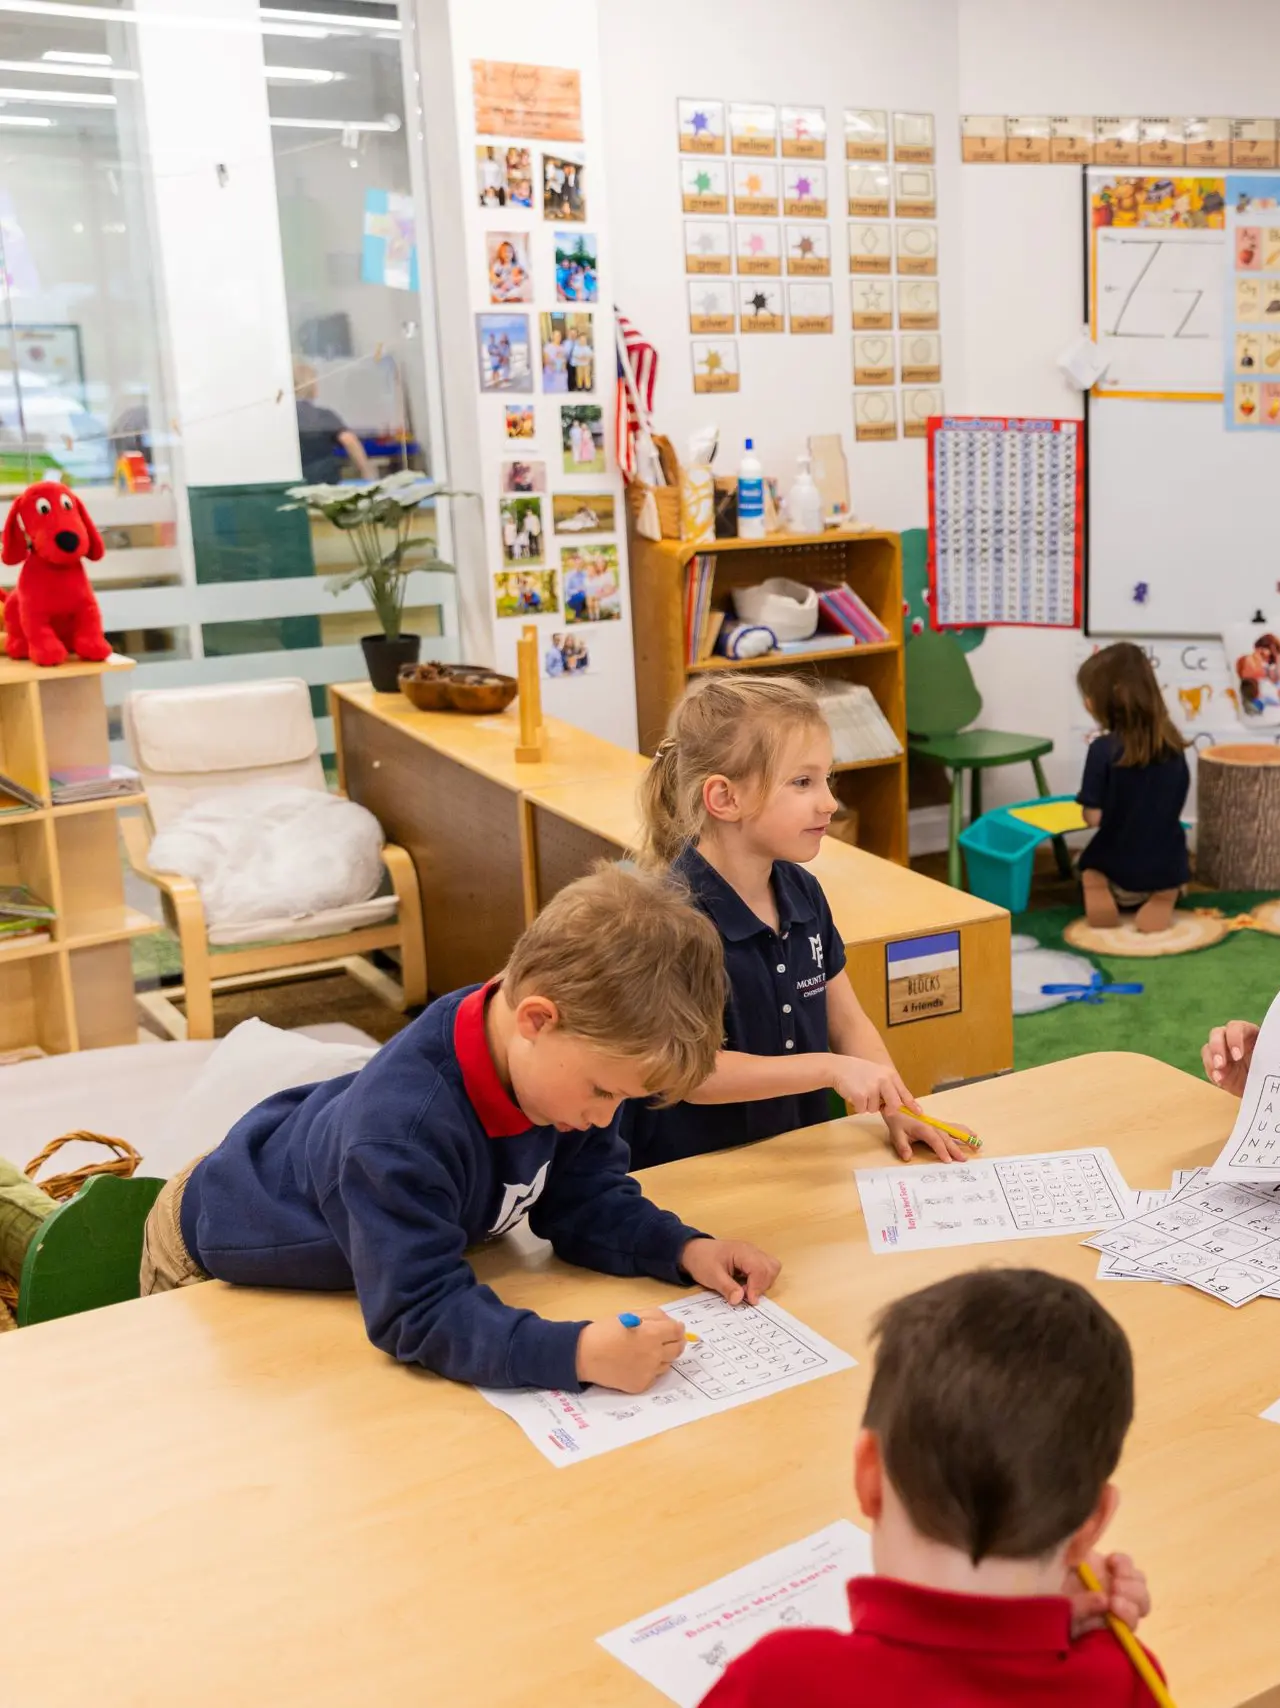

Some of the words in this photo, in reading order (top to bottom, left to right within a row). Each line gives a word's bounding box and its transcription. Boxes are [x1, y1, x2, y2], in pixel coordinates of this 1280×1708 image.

[737, 140, 770, 151] yellow
[690, 200, 720, 209] green
[739, 201, 774, 211] orange
[790, 203, 821, 214] purple
[700, 318, 727, 328] silver
[1181, 647, 1207, 671] Cc
[908, 976, 940, 996] BLOCKS
[902, 1004, 909, 1014] 4
[911, 999, 943, 1012] friends
[1200, 1201, 1224, 1213] n_p
[1156, 1221, 1180, 1232] v_t
[1248, 1219, 1271, 1231] f_x
[1154, 1262, 1177, 1271] f_n
[1250, 1258, 1278, 1270] m_n
[1205, 1277, 1229, 1292] t_g
[560, 1398, 574, 1412] Bee
[684, 1618, 722, 1639] Busy
[722, 1606, 750, 1621] Bee
[751, 1587, 787, 1607] Word
[789, 1563, 838, 1589] Search
